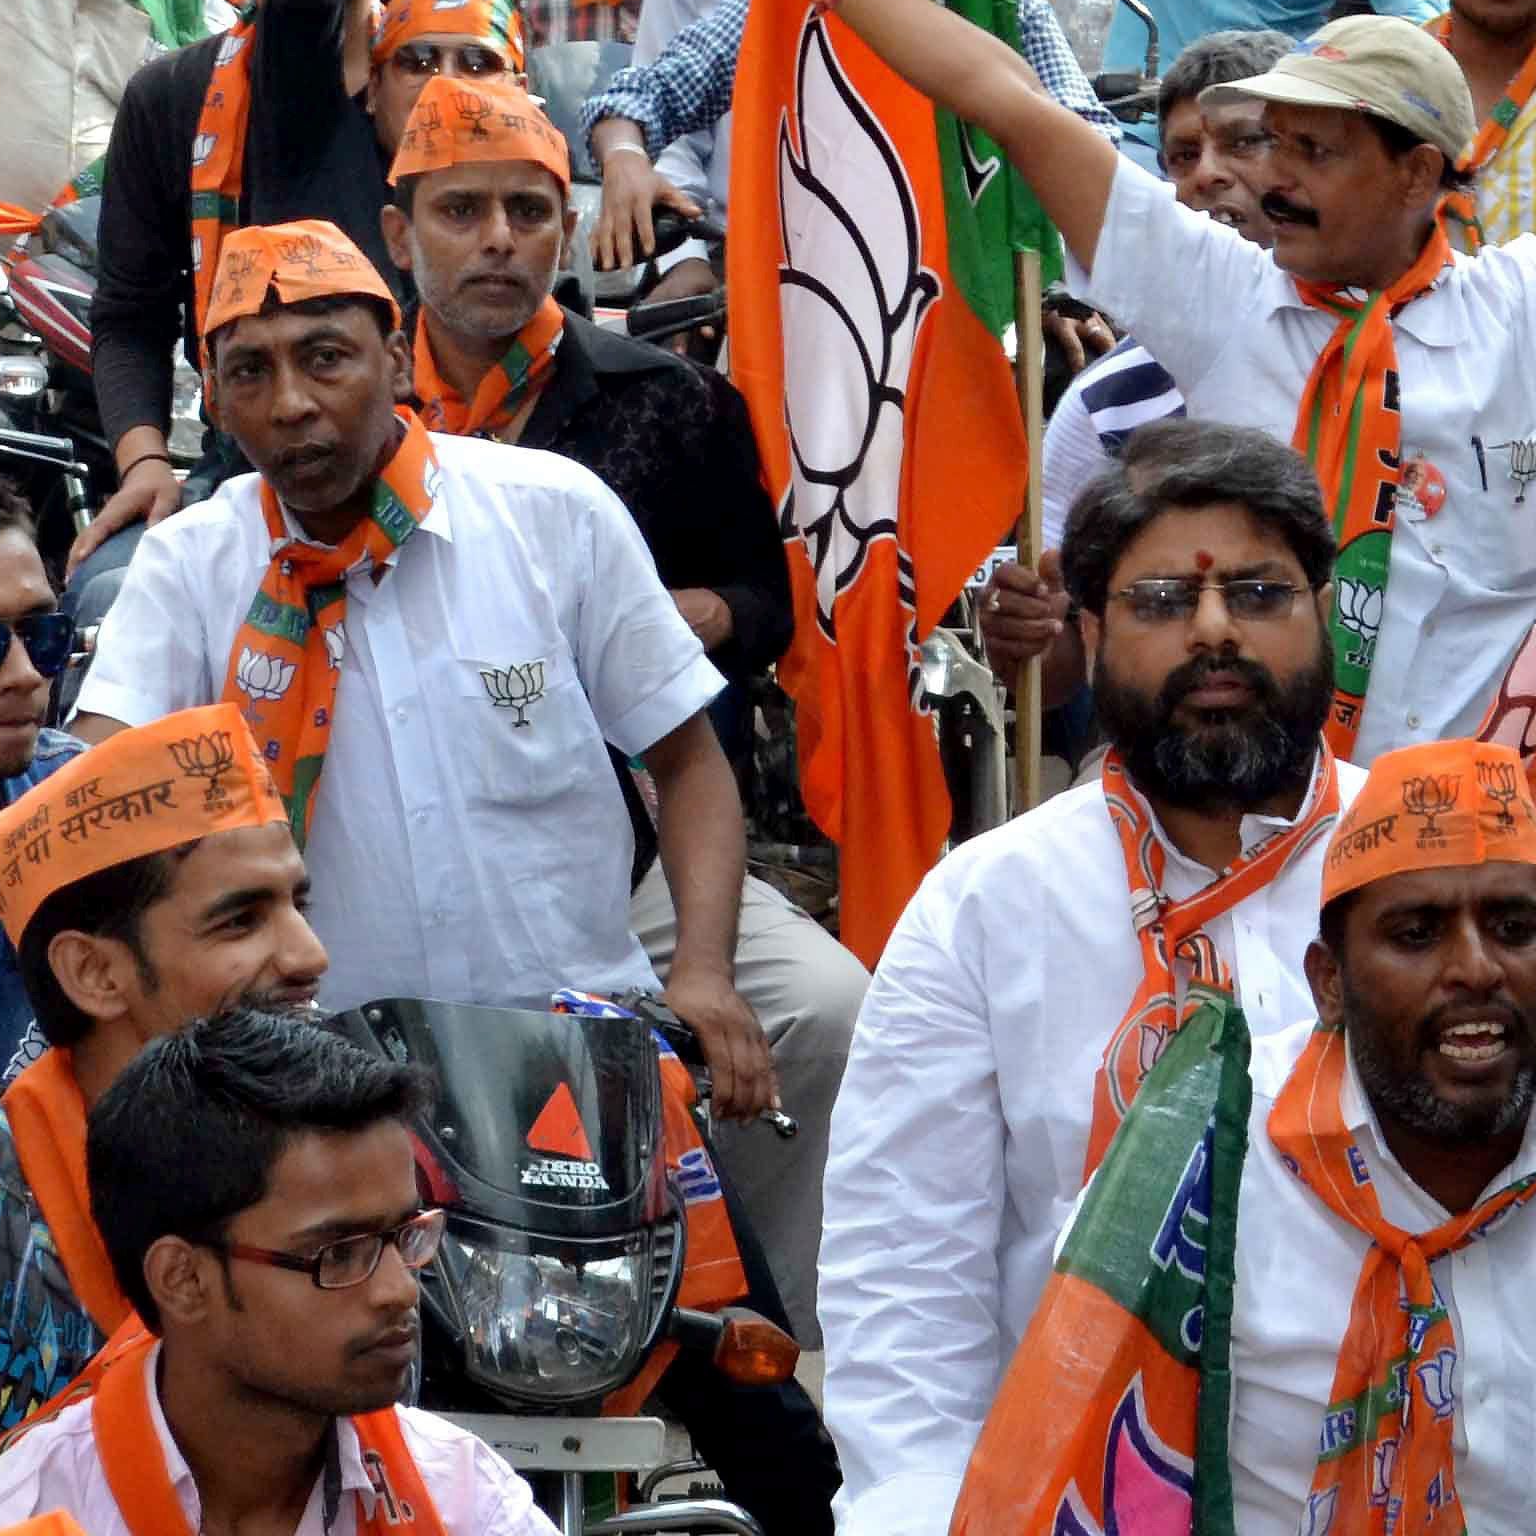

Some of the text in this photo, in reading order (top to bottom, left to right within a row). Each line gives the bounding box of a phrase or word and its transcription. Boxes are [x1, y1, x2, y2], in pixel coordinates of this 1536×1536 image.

[64, 777, 106, 811] बार
[24, 829, 56, 867] पा
[57, 779, 181, 846] सरकार
[1330, 814, 1400, 864] सरकार
[521, 1170, 610, 1191] HONDA
